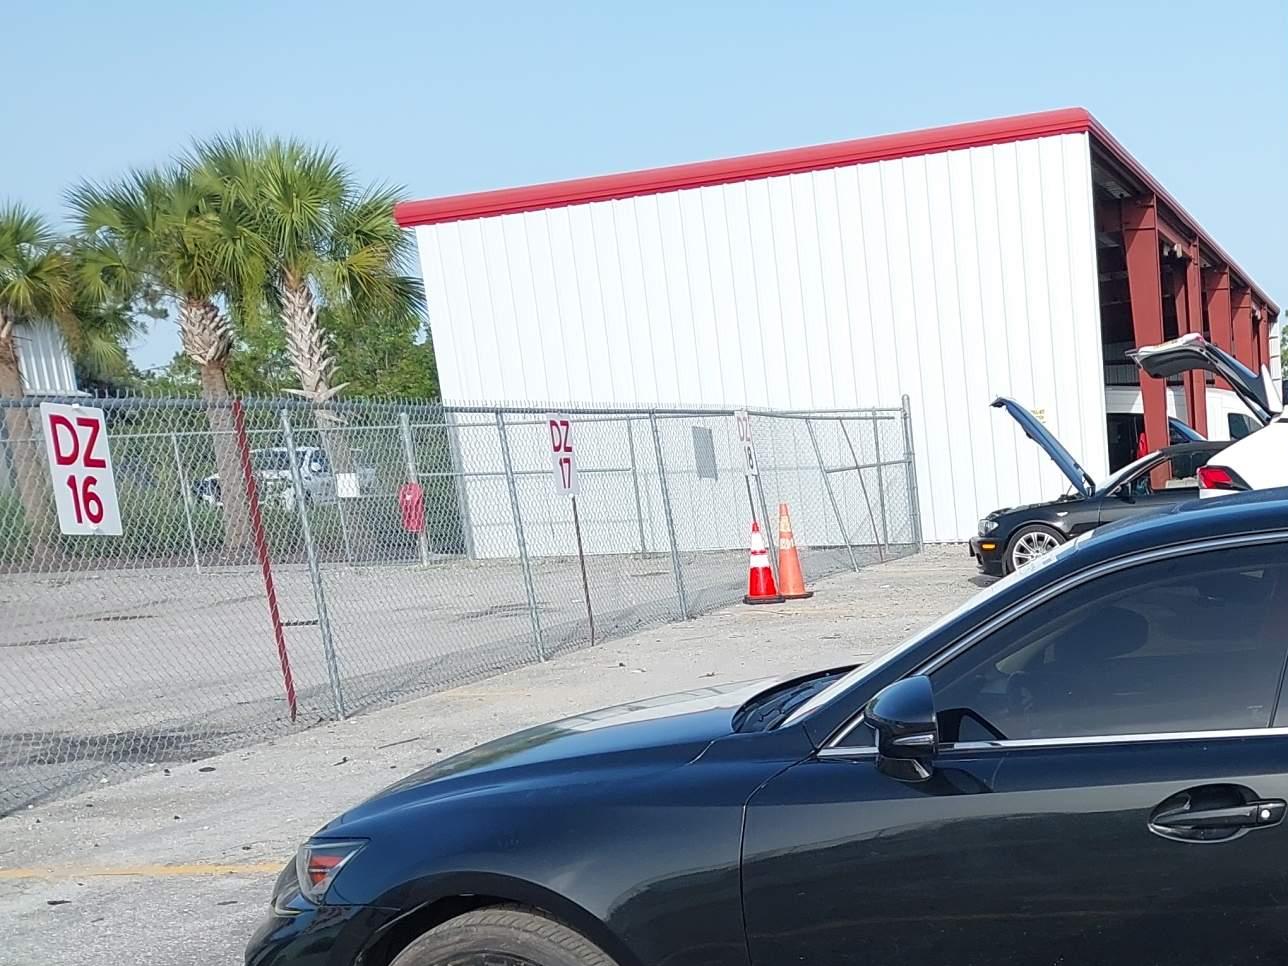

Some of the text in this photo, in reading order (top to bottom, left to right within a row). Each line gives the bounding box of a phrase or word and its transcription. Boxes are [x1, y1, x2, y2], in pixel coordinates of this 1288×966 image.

[48, 414, 107, 469] DZ
[549, 420, 573, 452] DZ
[559, 457, 571, 489] 17
[66, 474, 104, 524] 16
